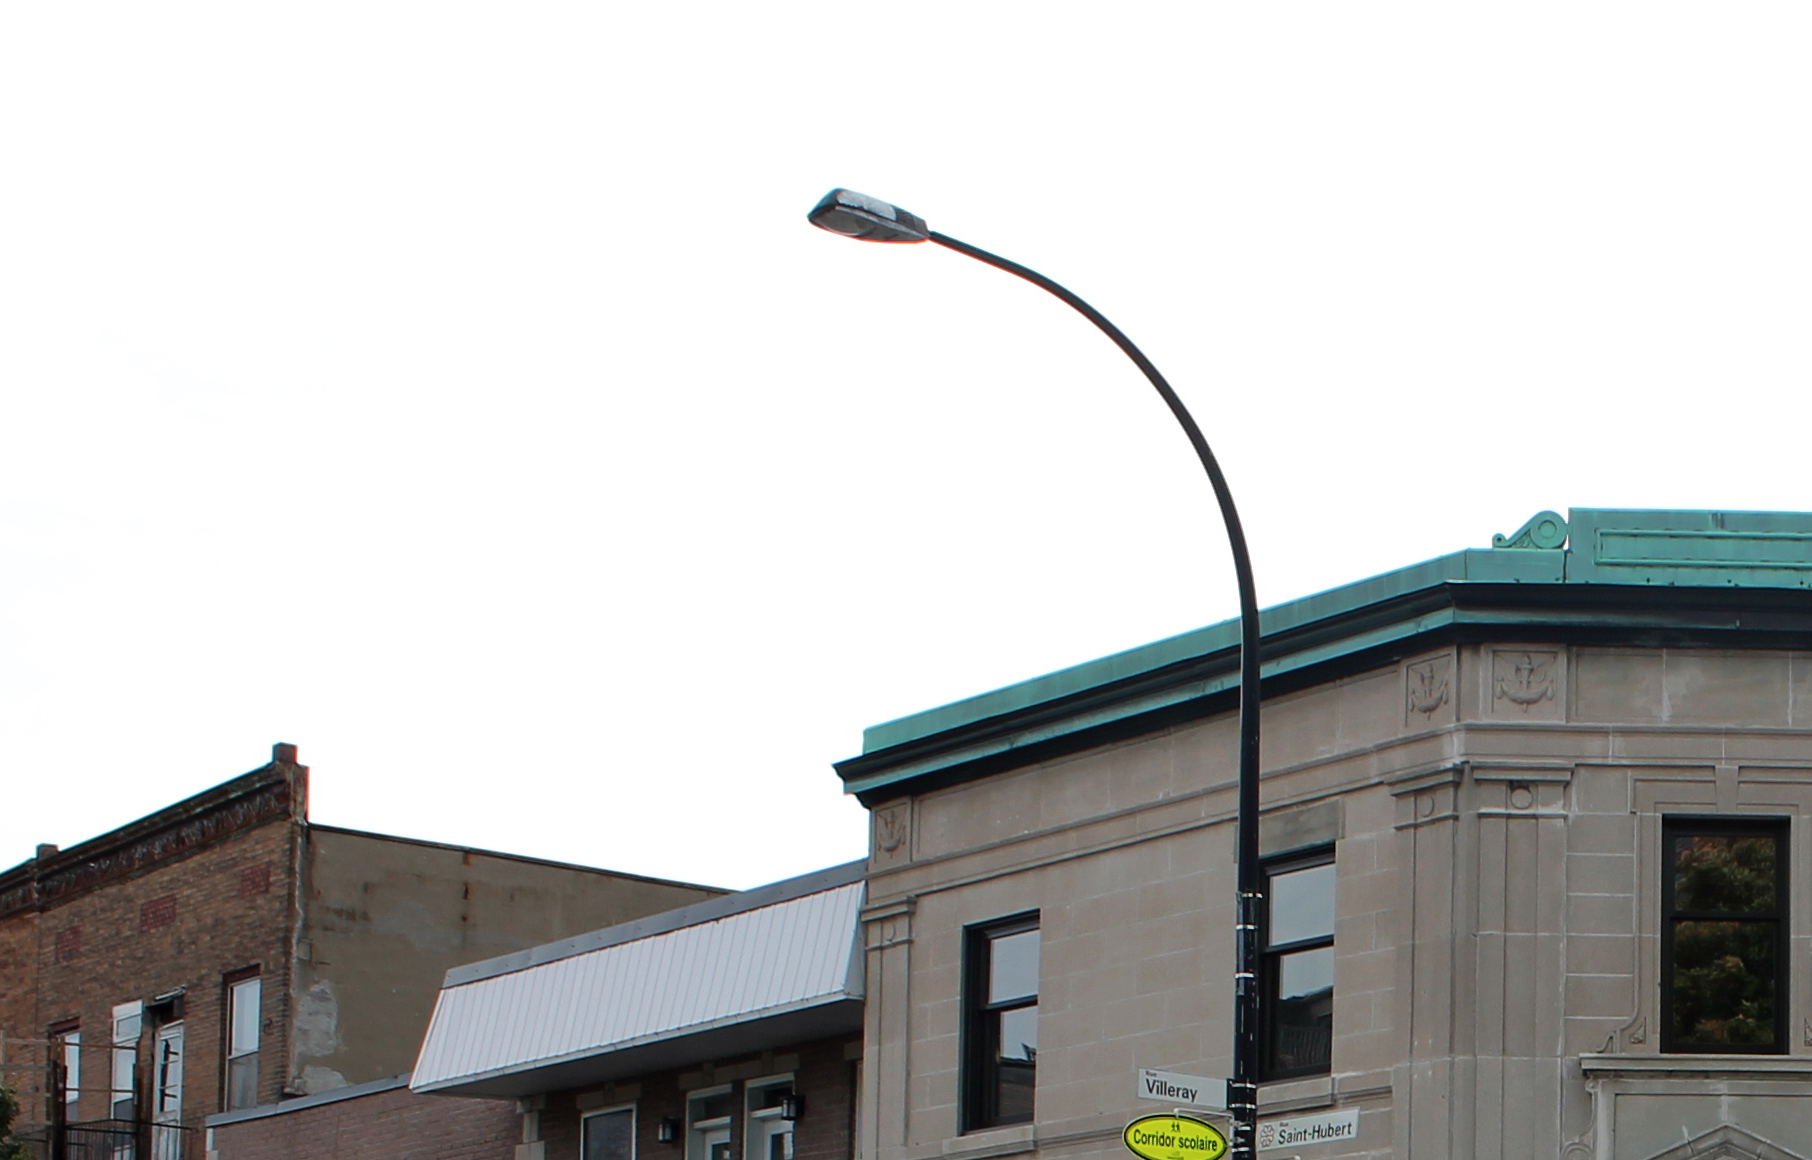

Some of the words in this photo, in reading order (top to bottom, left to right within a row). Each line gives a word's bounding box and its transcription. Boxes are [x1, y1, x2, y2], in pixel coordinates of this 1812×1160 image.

[1145, 1078, 1198, 1103] Villeray
[1133, 1128, 1176, 1147] Corridor
[1178, 1135, 1218, 1152] scolaire
[1278, 1122, 1353, 1144] Saint-Hubert
